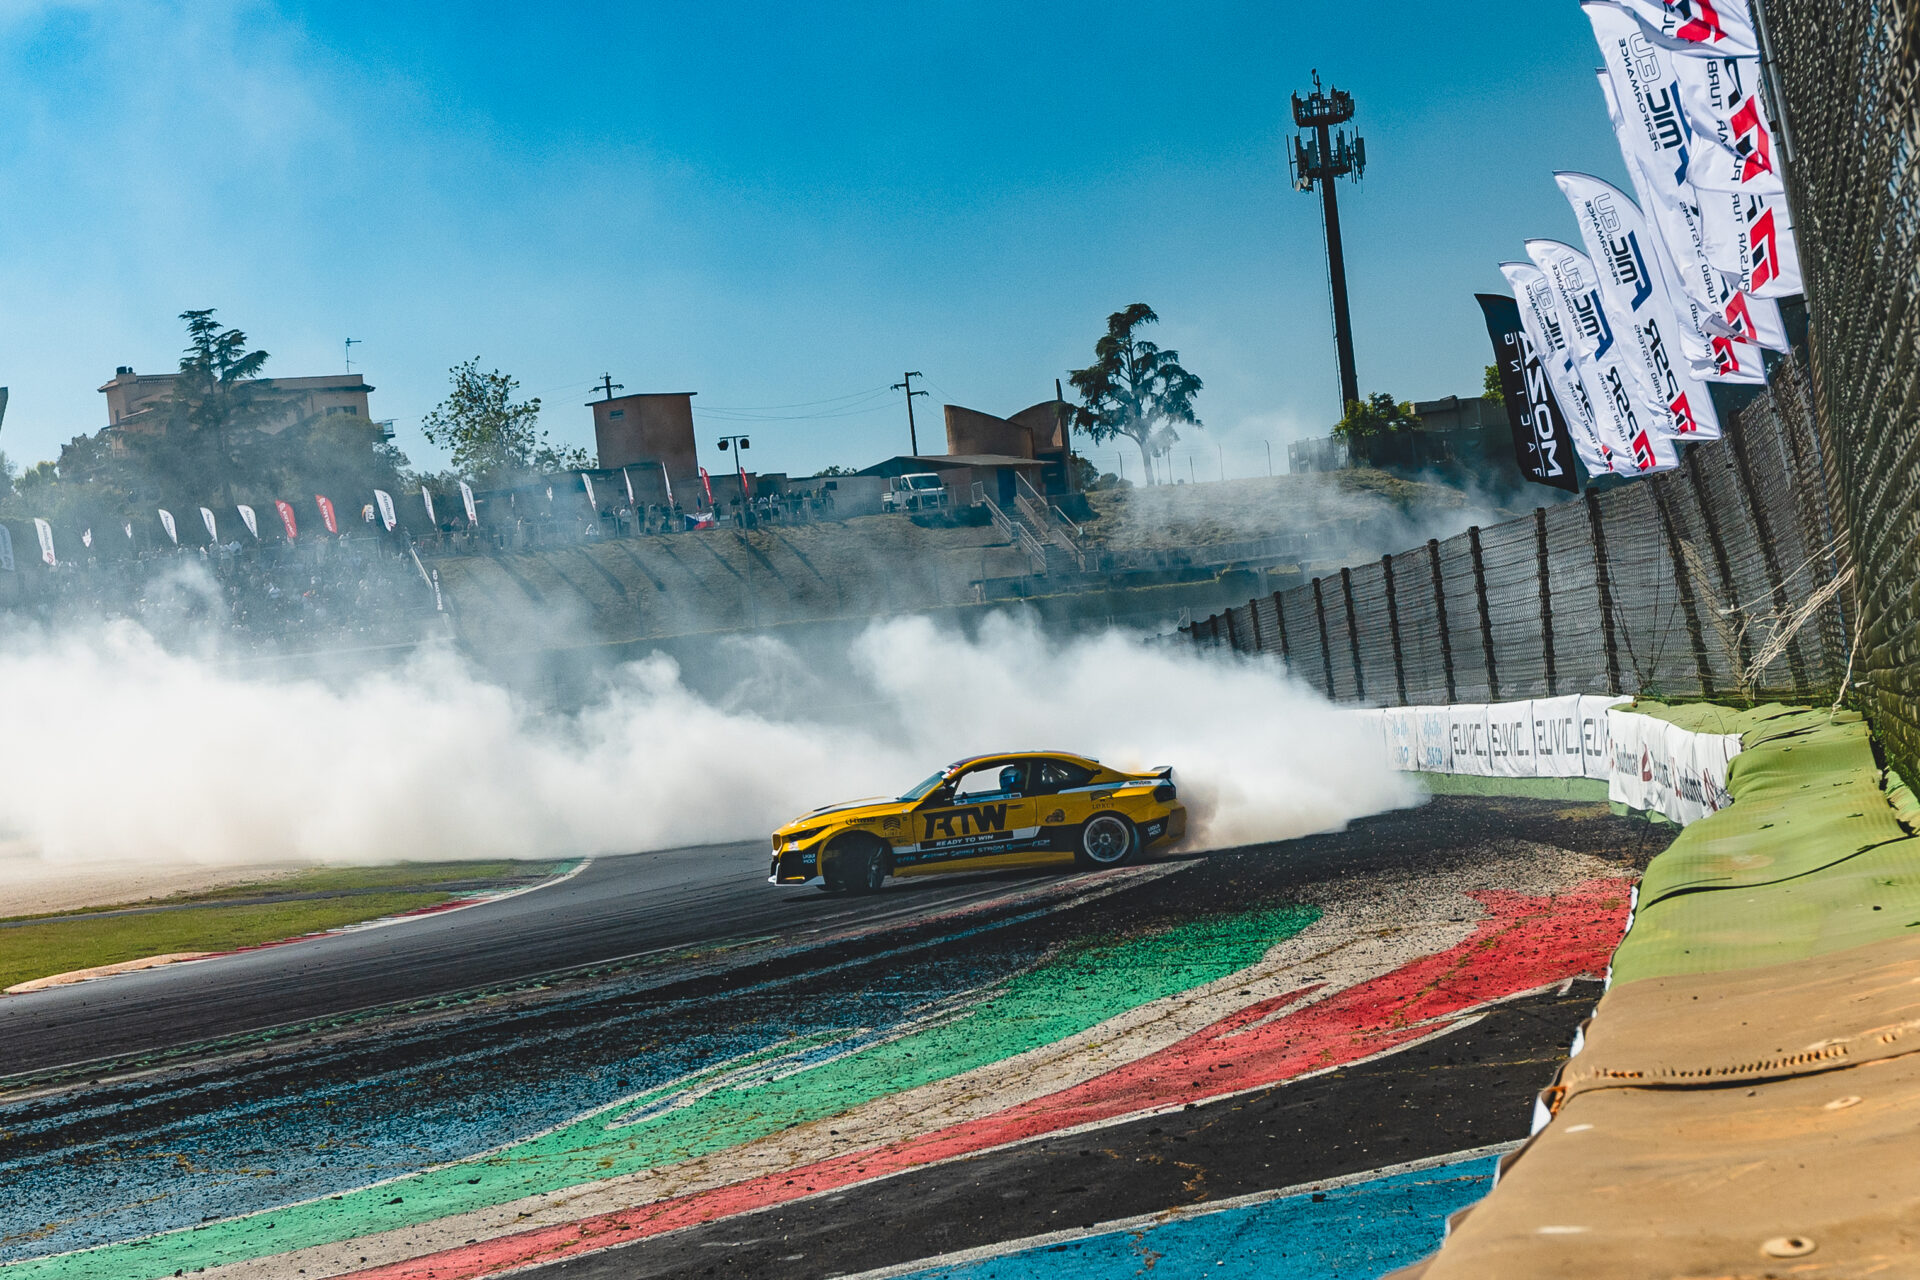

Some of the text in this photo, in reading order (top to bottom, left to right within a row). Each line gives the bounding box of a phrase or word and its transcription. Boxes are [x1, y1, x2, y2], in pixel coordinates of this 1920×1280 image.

[1583, 718, 1609, 757] EUV
[922, 804, 1009, 839] RTW
[936, 839, 962, 847] READY
[978, 834, 995, 842] WIN
